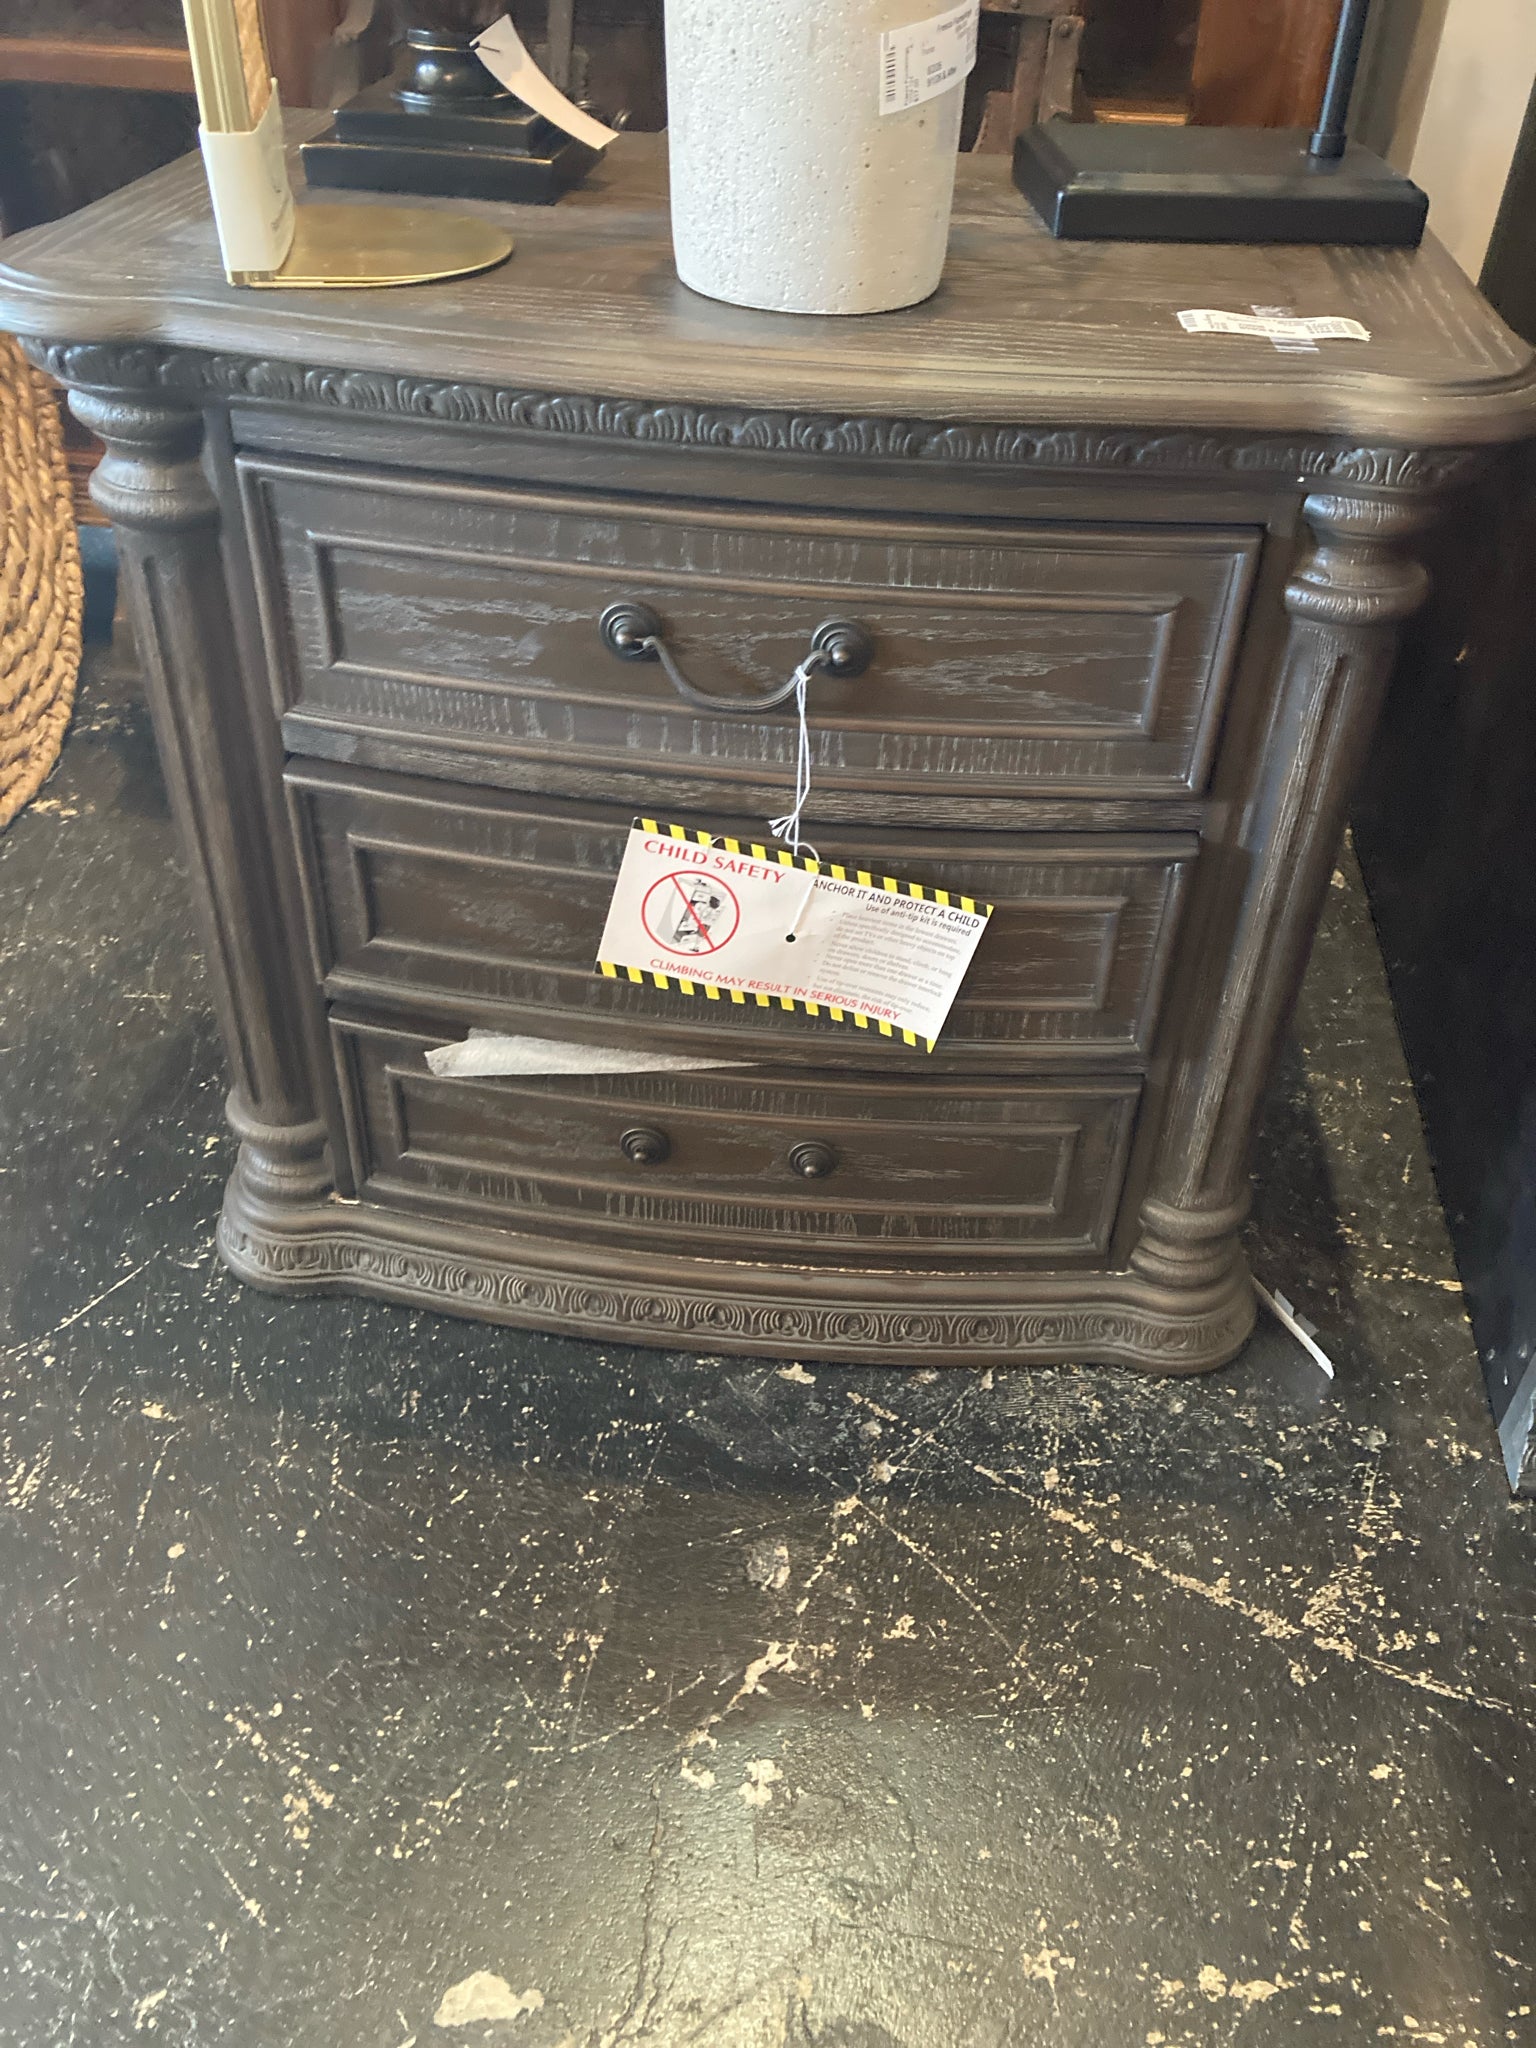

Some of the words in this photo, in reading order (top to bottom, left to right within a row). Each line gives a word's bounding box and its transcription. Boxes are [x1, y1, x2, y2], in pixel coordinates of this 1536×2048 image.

[644, 840, 707, 865] CHILD
[713, 856, 786, 884] SAFETY
[814, 879, 855, 898] ANCHOR
[856, 889, 868, 900] IT
[868, 893, 891, 905] AND
[893, 898, 937, 915] PROTECT
[937, 909, 945, 919] A
[948, 911, 980, 928] CHILD
[866, 904, 879, 913] Use
[890, 910, 918, 923] anti-tip
[919, 914, 930, 925] kit
[931, 918, 938, 927] is
[939, 922, 972, 937] required
[650, 958, 714, 980] CLIMBING
[716, 974, 746, 986] MAY
[748, 979, 791, 994] RESULT
[793, 987, 808, 996] IN
[810, 990, 858, 1008] SERIOUS
[860, 1001, 902, 1021] INJURY
